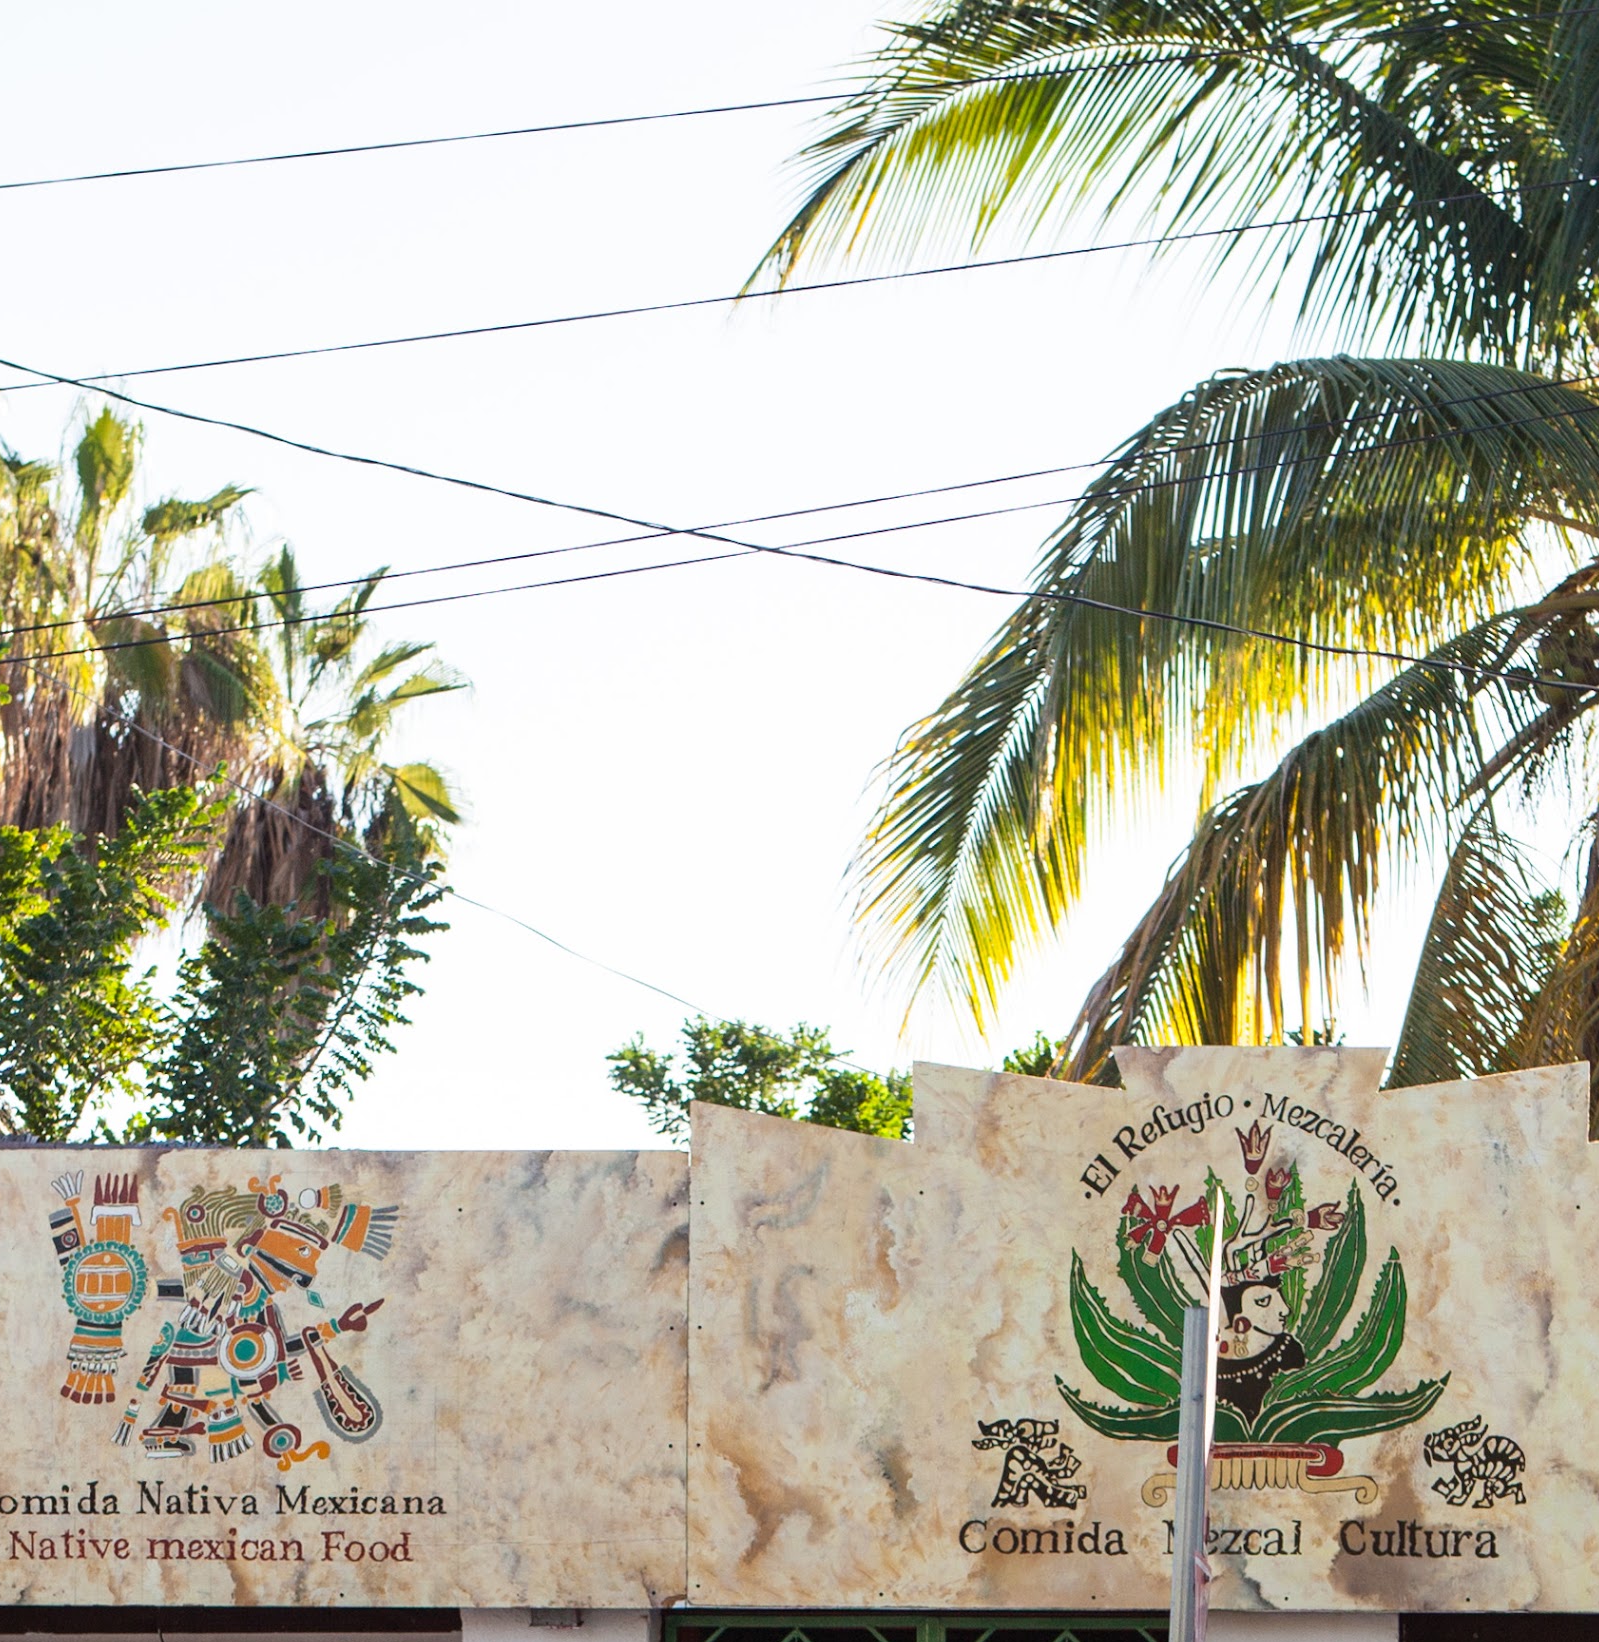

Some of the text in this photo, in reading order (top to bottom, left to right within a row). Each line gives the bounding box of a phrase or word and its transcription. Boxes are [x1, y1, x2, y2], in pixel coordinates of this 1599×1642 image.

[1080, 1092, 1399, 1201] El Refugio Mezcalería
[137, 1480, 260, 1516] Nativa
[276, 1484, 447, 1516] Mexicana
[9, 1528, 414, 1563] Native mexican Food
[958, 1520, 1127, 1557] Comida
[1339, 1519, 1500, 1559] Cultura
